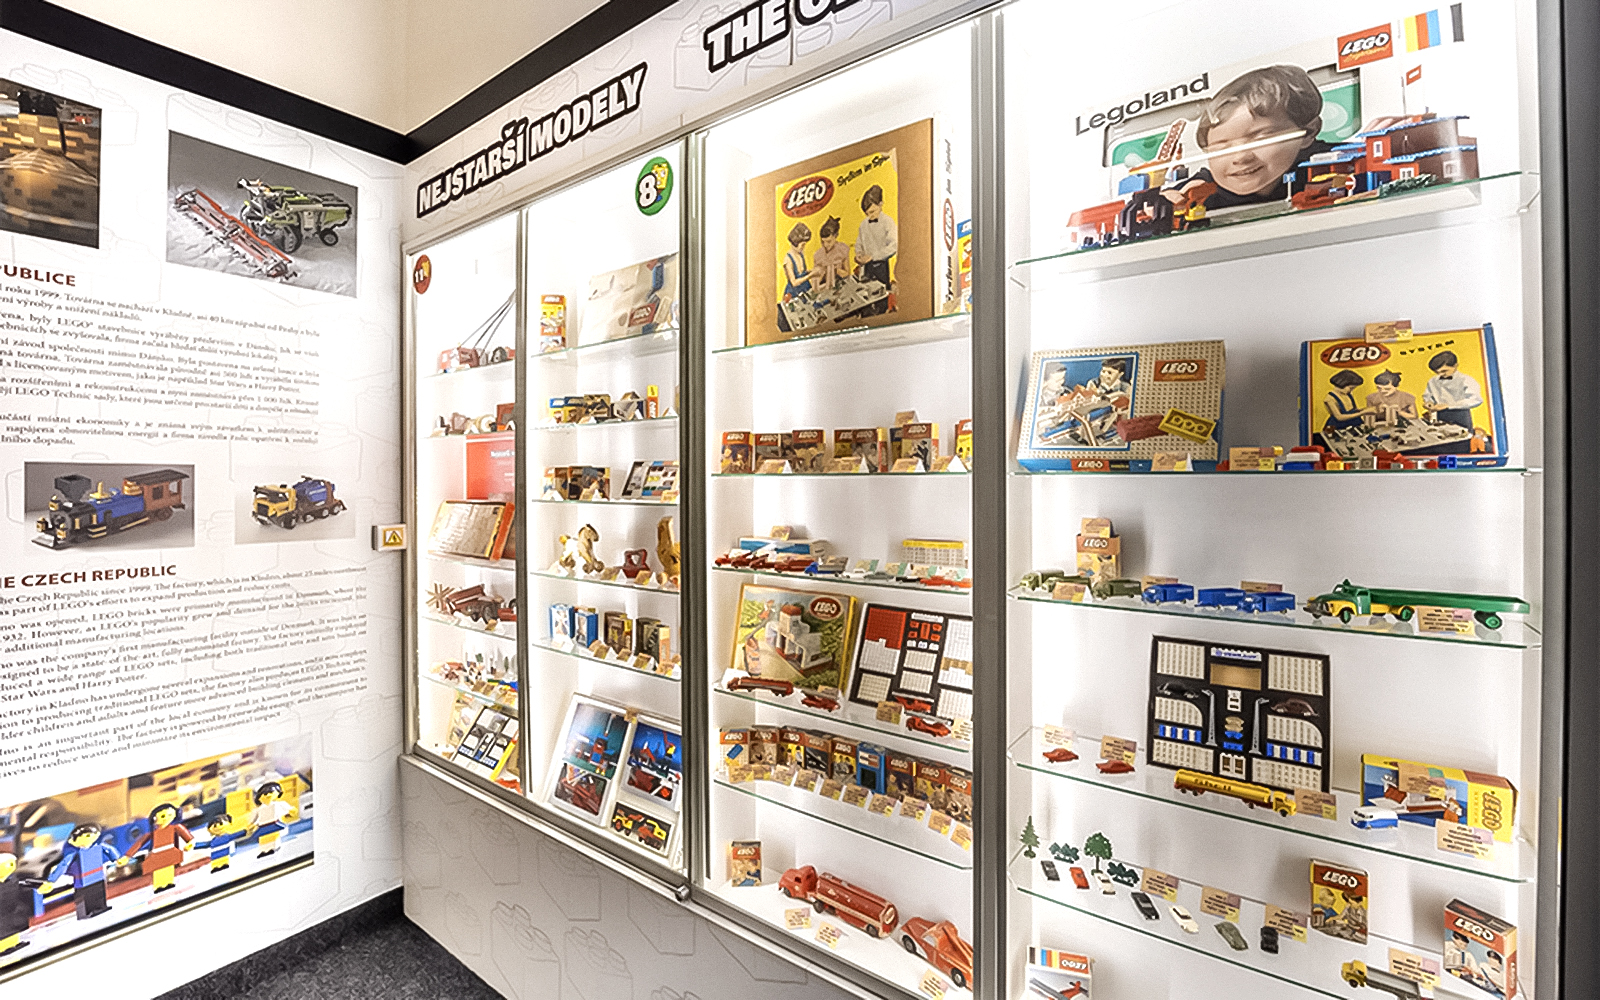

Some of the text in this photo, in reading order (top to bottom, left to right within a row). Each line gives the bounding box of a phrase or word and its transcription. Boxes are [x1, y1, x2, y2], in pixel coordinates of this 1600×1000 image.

[704, 1, 790, 72] THE
[1340, 32, 1390, 56] LEGO
[1075, 72, 1210, 136] Legoland
[417, 62, 647, 217] NEJSTARŠÍ MODELY
[638, 173, 658, 209] 8
[786, 178, 829, 212] LEGO
[0, 264, 76, 287] UBLICE
[414, 268, 426, 284] 11
[5, 285, 104, 305] roku Továrna
[16, 298, 53, 310] výroby
[12, 339, 104, 354] závod společnosti
[1329, 339, 1456, 364] LEGO SYSTEM
[64, 354, 104, 365] Továrna
[1161, 361, 1199, 375] LEGO
[15, 386, 49, 395] LEGO
[51, 389, 91, 399] Technic
[6, 425, 54, 434] napájena
[37, 415, 129, 427] místní ekonomiky
[1077, 460, 1104, 470] LEGO
[1083, 538, 1108, 548] LEGO
[21, 571, 86, 588] CZECH
[92, 565, 176, 582] REPUBLIC
[12, 606, 35, 616] part
[53, 600, 94, 610] LEGO's
[95, 598, 128, 606] efforts
[141, 591, 175, 602] expand
[177, 588, 225, 599] production
[226, 585, 242, 593] and
[15, 593, 50, 602] Czech
[53, 589, 98, 600] Republic
[153, 582, 170, 590] The
[45, 615, 88, 627] opened,
[92, 611, 123, 620] LEGO
[127, 608, 156, 617] bricks
[183, 600, 225, 612] primarily
[814, 600, 838, 614] LEGO
[31, 608, 231, 638] However, LEGO's popularity grew and
[4, 631, 141, 653] additional manufacturing
[40, 655, 58, 663] the
[61, 647, 116, 660] company's
[118, 644, 138, 652] first
[140, 635, 208, 649] manufacturing
[209, 631, 238, 640] facility
[122, 654, 138, 662] the
[161, 647, 182, 656] fully
[184, 640, 229, 653] automated
[47, 673, 73, 683] wide
[77, 670, 106, 679] range
[124, 661, 154, 671] LEGO
[180, 652, 222, 662] including
[223, 647, 243, 656] both
[305, 635, 319, 643] and
[1, 693, 23, 701] Star
[27, 689, 56, 697] Wars
[59, 682, 79, 692] and
[82, 680, 111, 688] Harry
[49, 697, 88, 709] Kladno
[108, 685, 160, 698] undergone
[161, 677, 192, 689] several
[241, 667, 256, 675] and
[26, 686, 246, 735] children and adults and feature more advanced
[36, 707, 92, 724] producing
[94, 695, 147, 711] traditional
[149, 690, 178, 701] LEGO
[217, 680, 246, 688] factory
[55, 728, 109, 744] important
[113, 723, 133, 734] part
[168, 710, 190, 721] local
[234, 698, 249, 707] and
[117, 733, 133, 741] The
[135, 726, 168, 737] factory
[178, 715, 216, 730] powered
[42, 742, 130, 768] reduce waste and
[1482, 792, 1503, 832] LEGO
[1322, 870, 1359, 888] LEGO
[1454, 916, 1495, 942] LEGO
